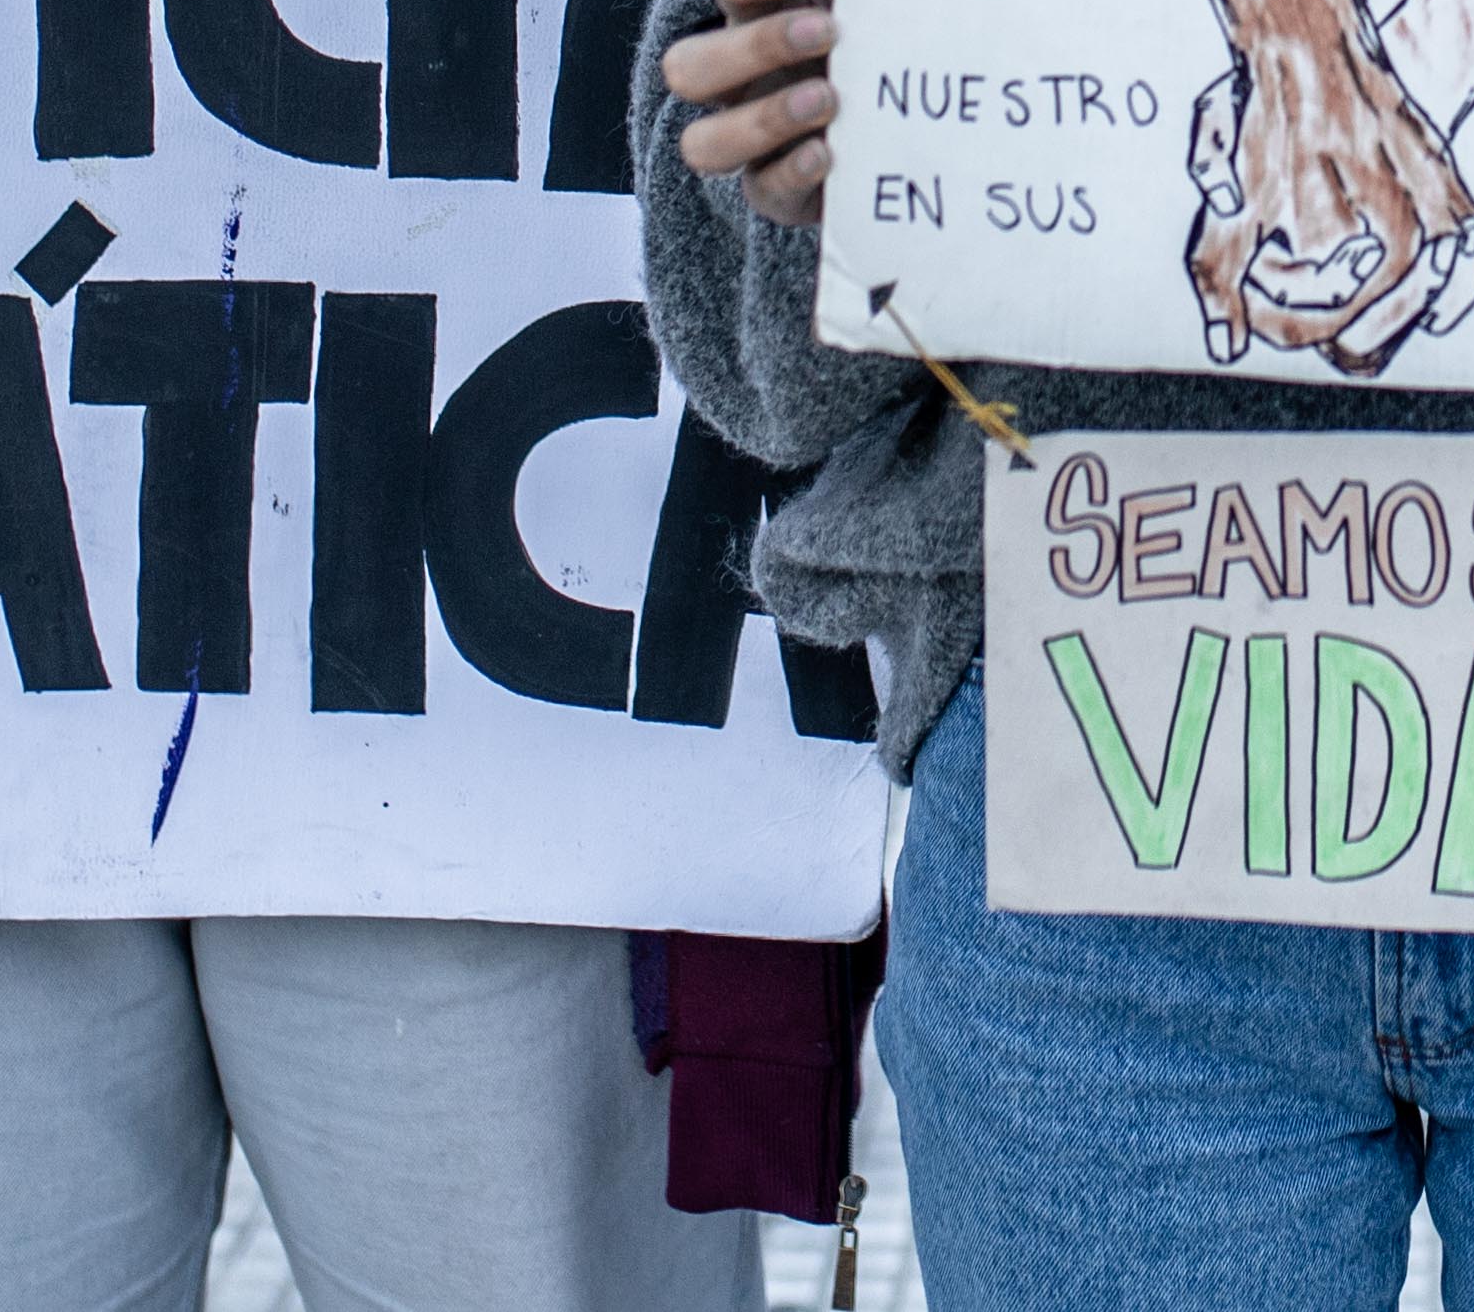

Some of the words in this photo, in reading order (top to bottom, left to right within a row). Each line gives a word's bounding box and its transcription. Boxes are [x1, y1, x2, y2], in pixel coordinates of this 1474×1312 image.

[879, 71, 1158, 126] NUESTRO
[875, 176, 943, 228] EN
[987, 184, 1095, 233] SUS
